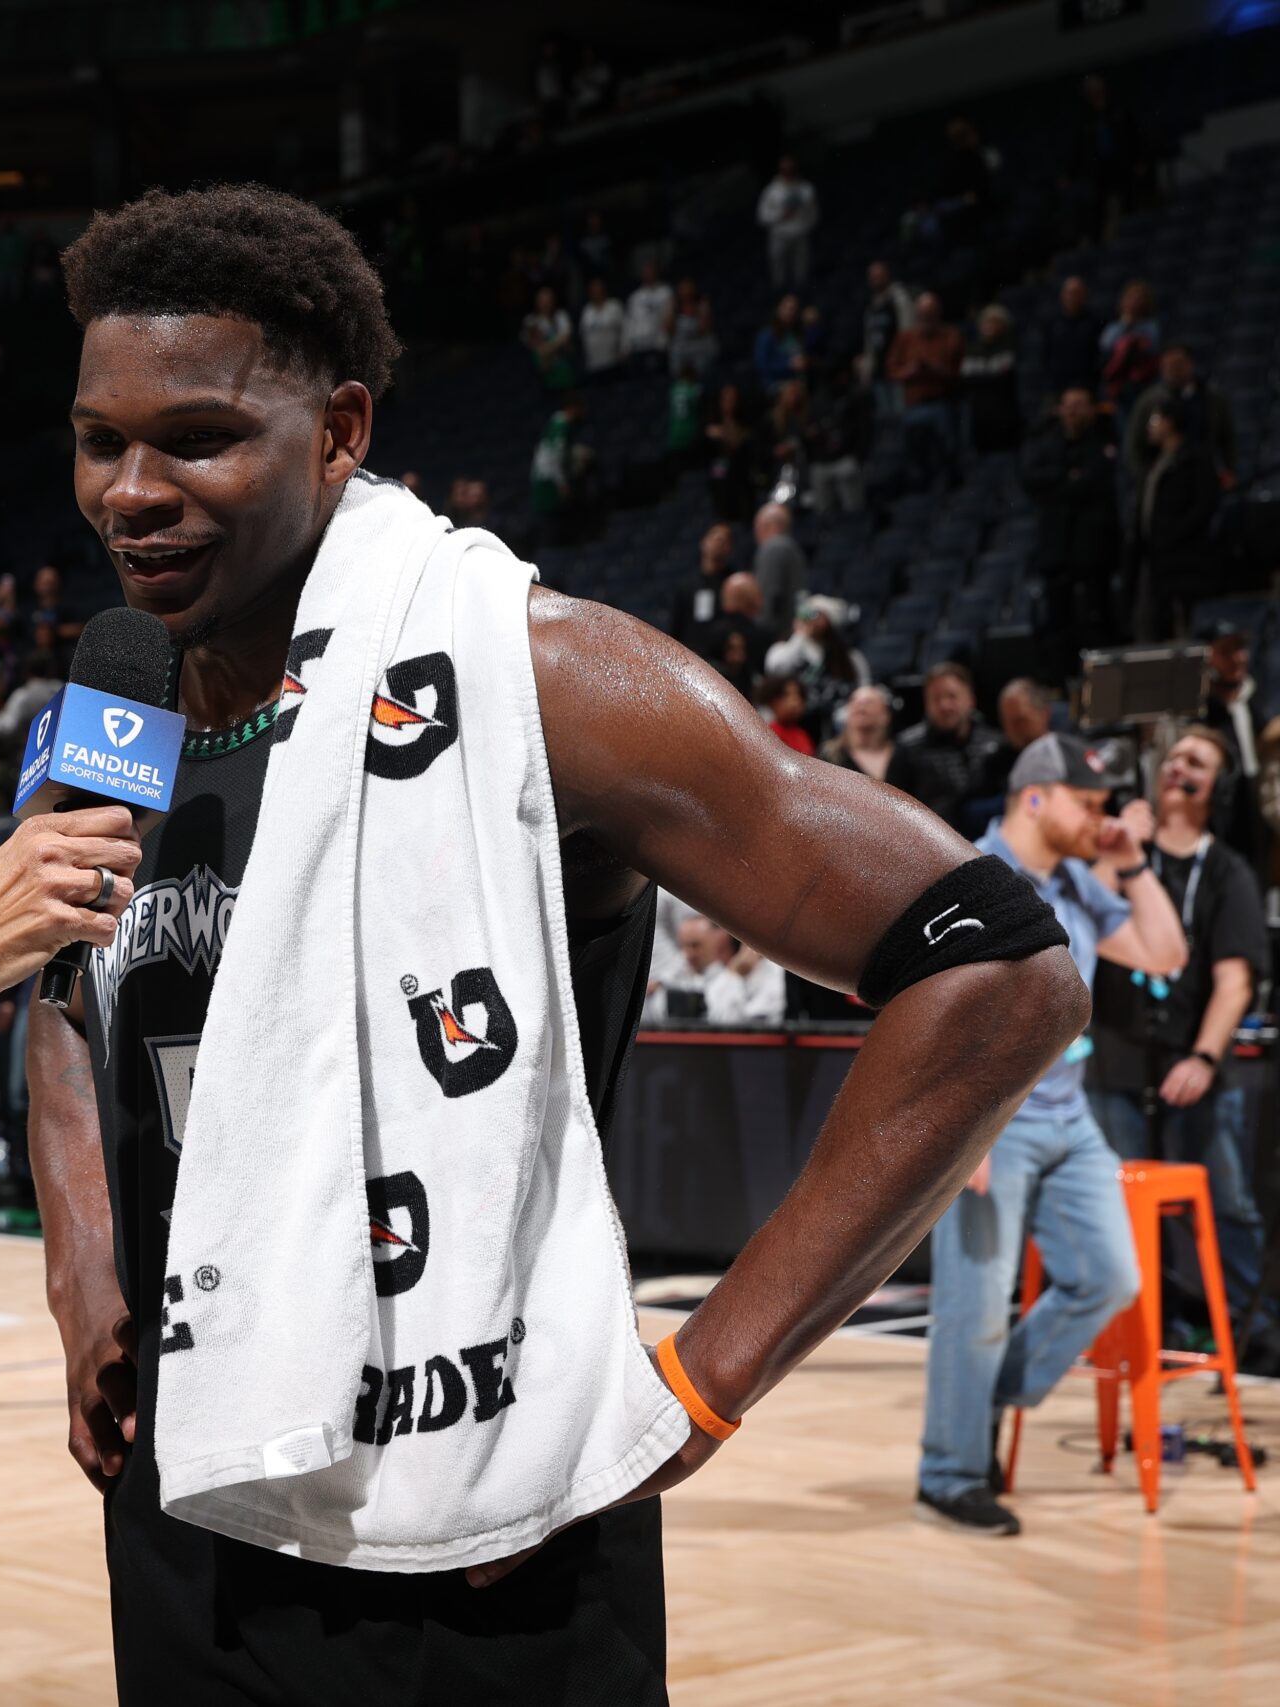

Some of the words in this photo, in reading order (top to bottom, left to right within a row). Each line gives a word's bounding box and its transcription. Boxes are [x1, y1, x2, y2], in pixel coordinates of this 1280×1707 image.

[60, 762, 104, 784] SPORTS
[105, 776, 161, 800] NETWORK
[62, 742, 164, 786] FANDUEL
